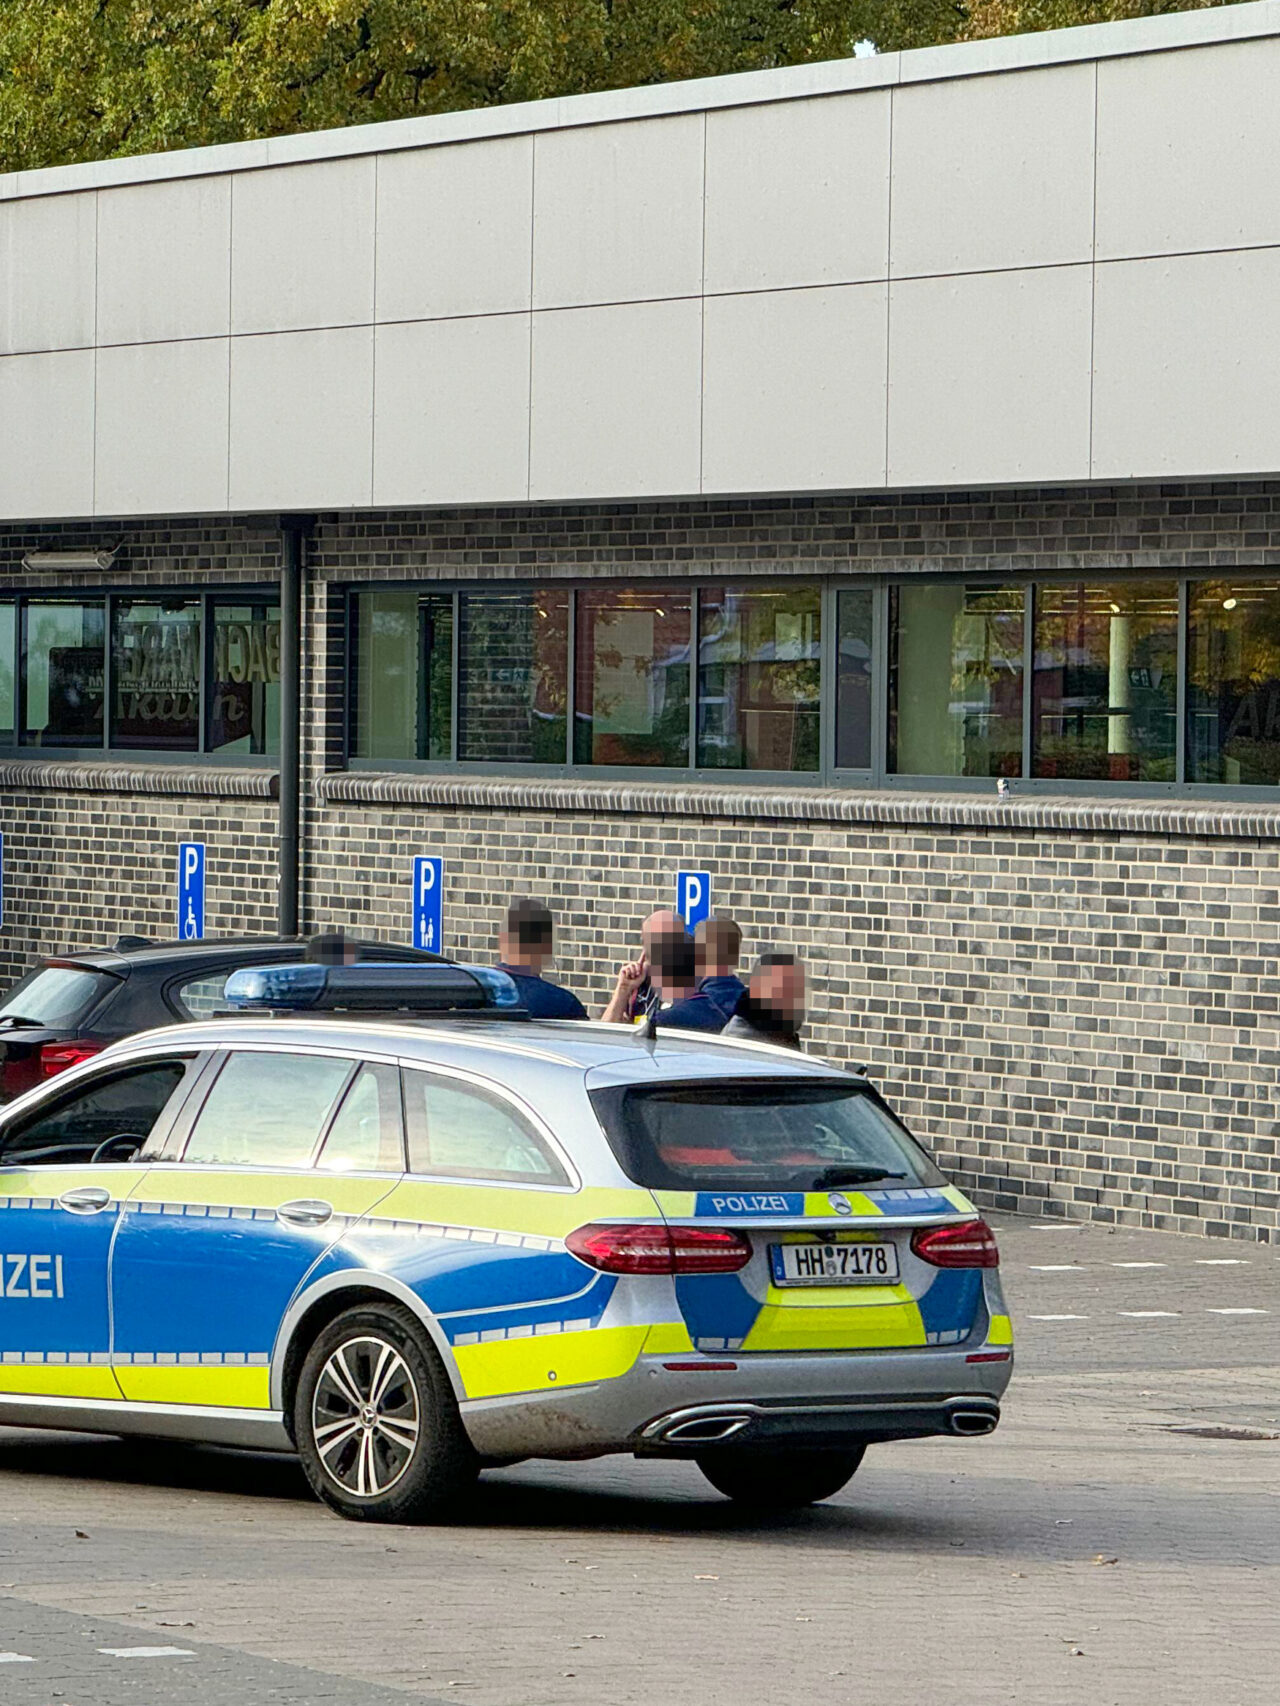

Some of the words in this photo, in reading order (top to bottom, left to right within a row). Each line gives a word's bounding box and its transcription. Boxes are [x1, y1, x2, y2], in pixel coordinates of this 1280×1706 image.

[185, 847, 199, 891] P
[420, 860, 435, 907] P
[685, 876, 702, 926] P
[711, 1196, 790, 1213] POLIZEI
[795, 1248, 825, 1276] HH
[837, 1247, 888, 1275] 7178
